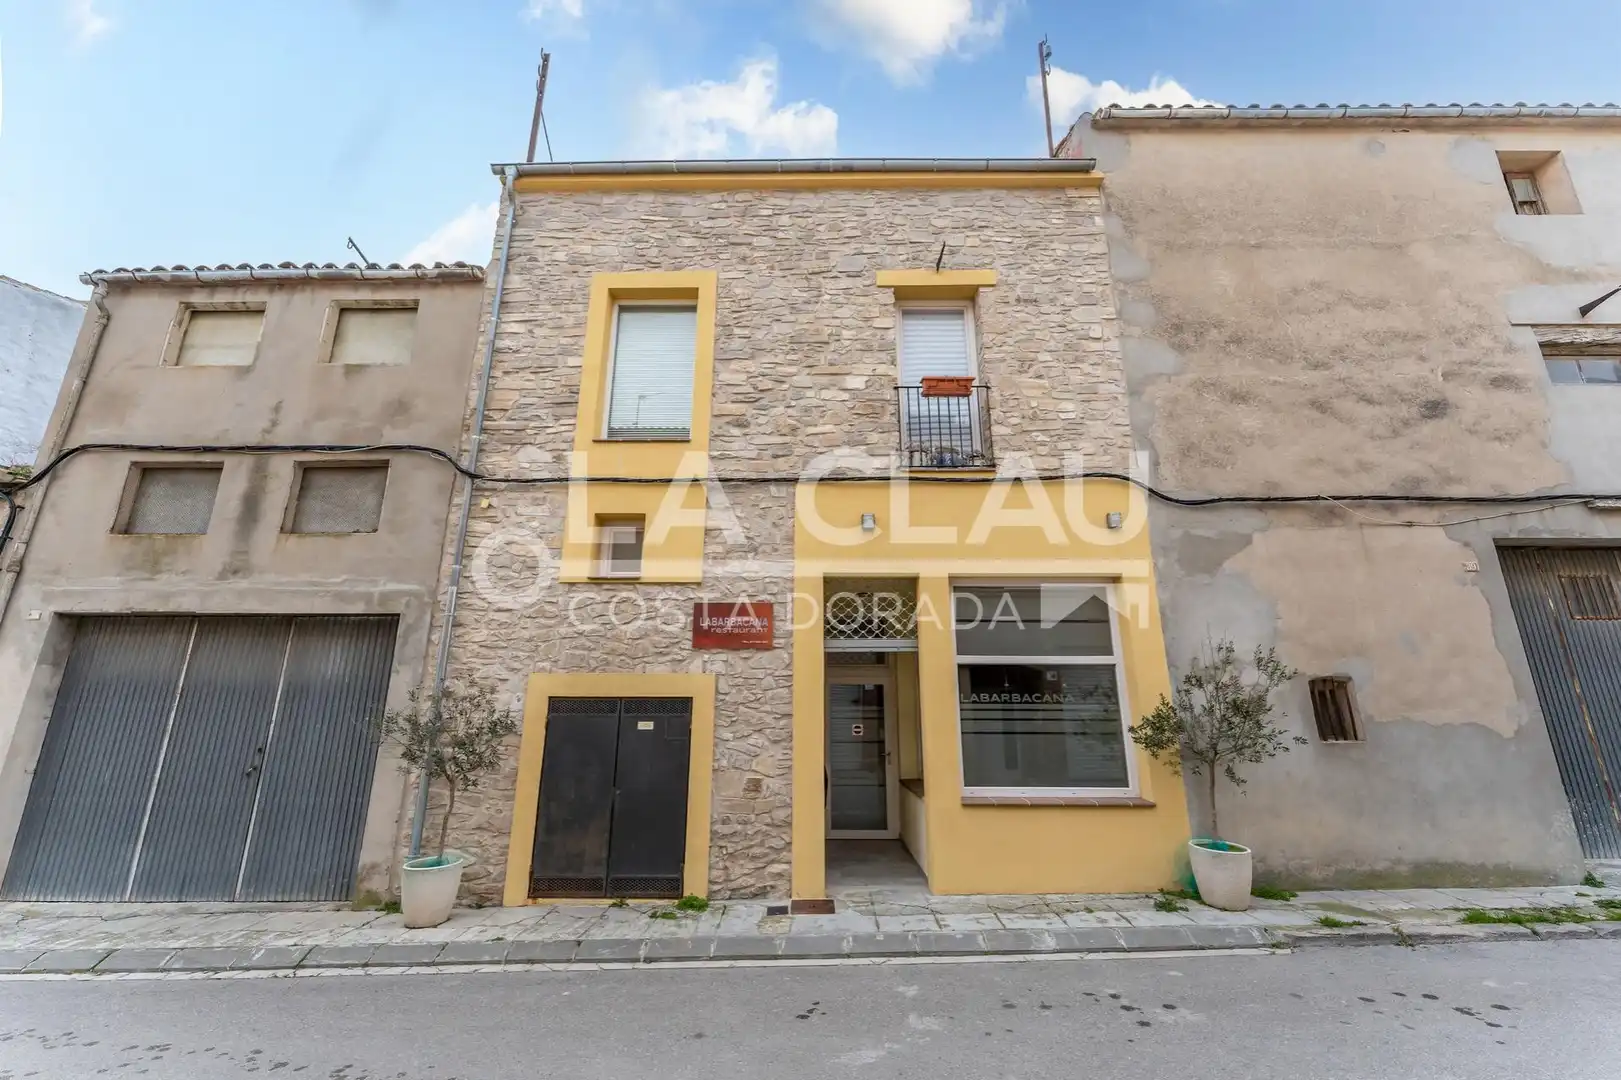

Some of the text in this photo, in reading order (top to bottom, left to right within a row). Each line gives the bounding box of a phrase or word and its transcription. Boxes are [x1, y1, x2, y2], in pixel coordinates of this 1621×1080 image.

[700, 617, 768, 627] LABARBACANA
[710, 626, 768, 634] restaurant
[961, 693, 1075, 703] LABARBACANA
